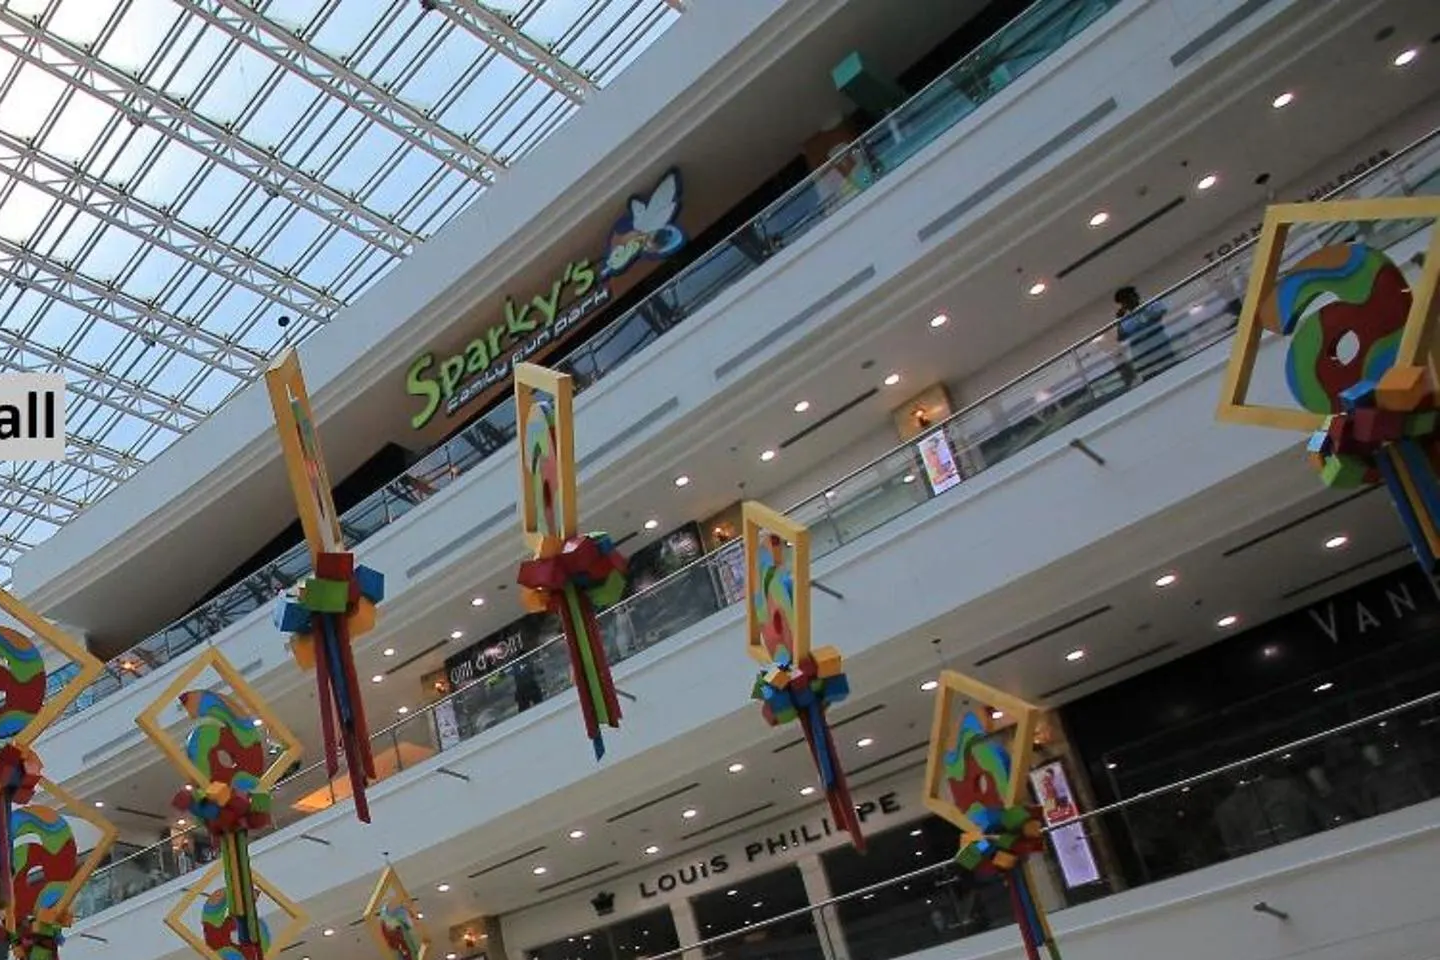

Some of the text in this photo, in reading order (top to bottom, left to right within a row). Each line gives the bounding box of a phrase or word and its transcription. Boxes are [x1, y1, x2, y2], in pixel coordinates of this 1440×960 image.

[406, 258, 595, 430] Sparky's
[1307, 582, 1417, 644] VAN
[638, 792, 901, 899] LOUIS PHILIPE
